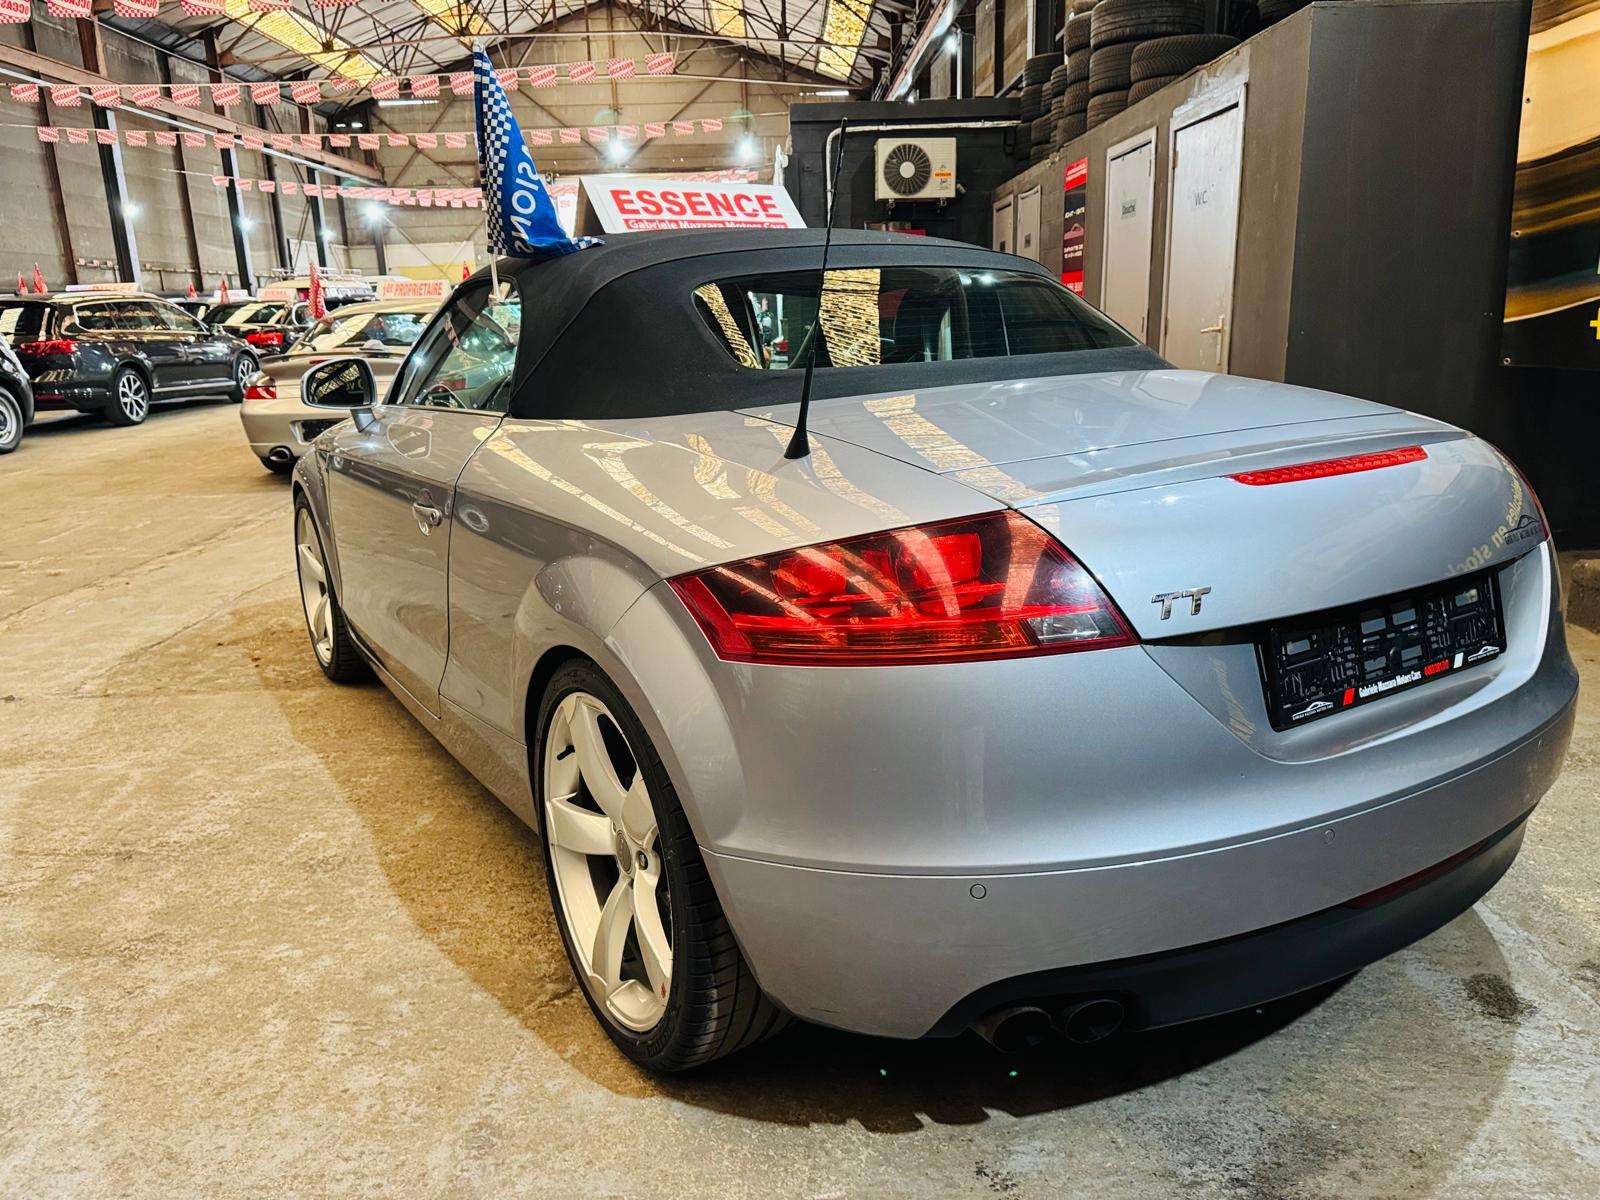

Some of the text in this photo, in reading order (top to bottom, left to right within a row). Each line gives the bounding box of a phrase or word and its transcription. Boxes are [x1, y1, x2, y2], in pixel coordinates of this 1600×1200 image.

[609, 189, 783, 219] ESSENCE
[1194, 190, 1208, 207] WC
[628, 219, 678, 231] Gabriele
[1151, 586, 1212, 620] TT
